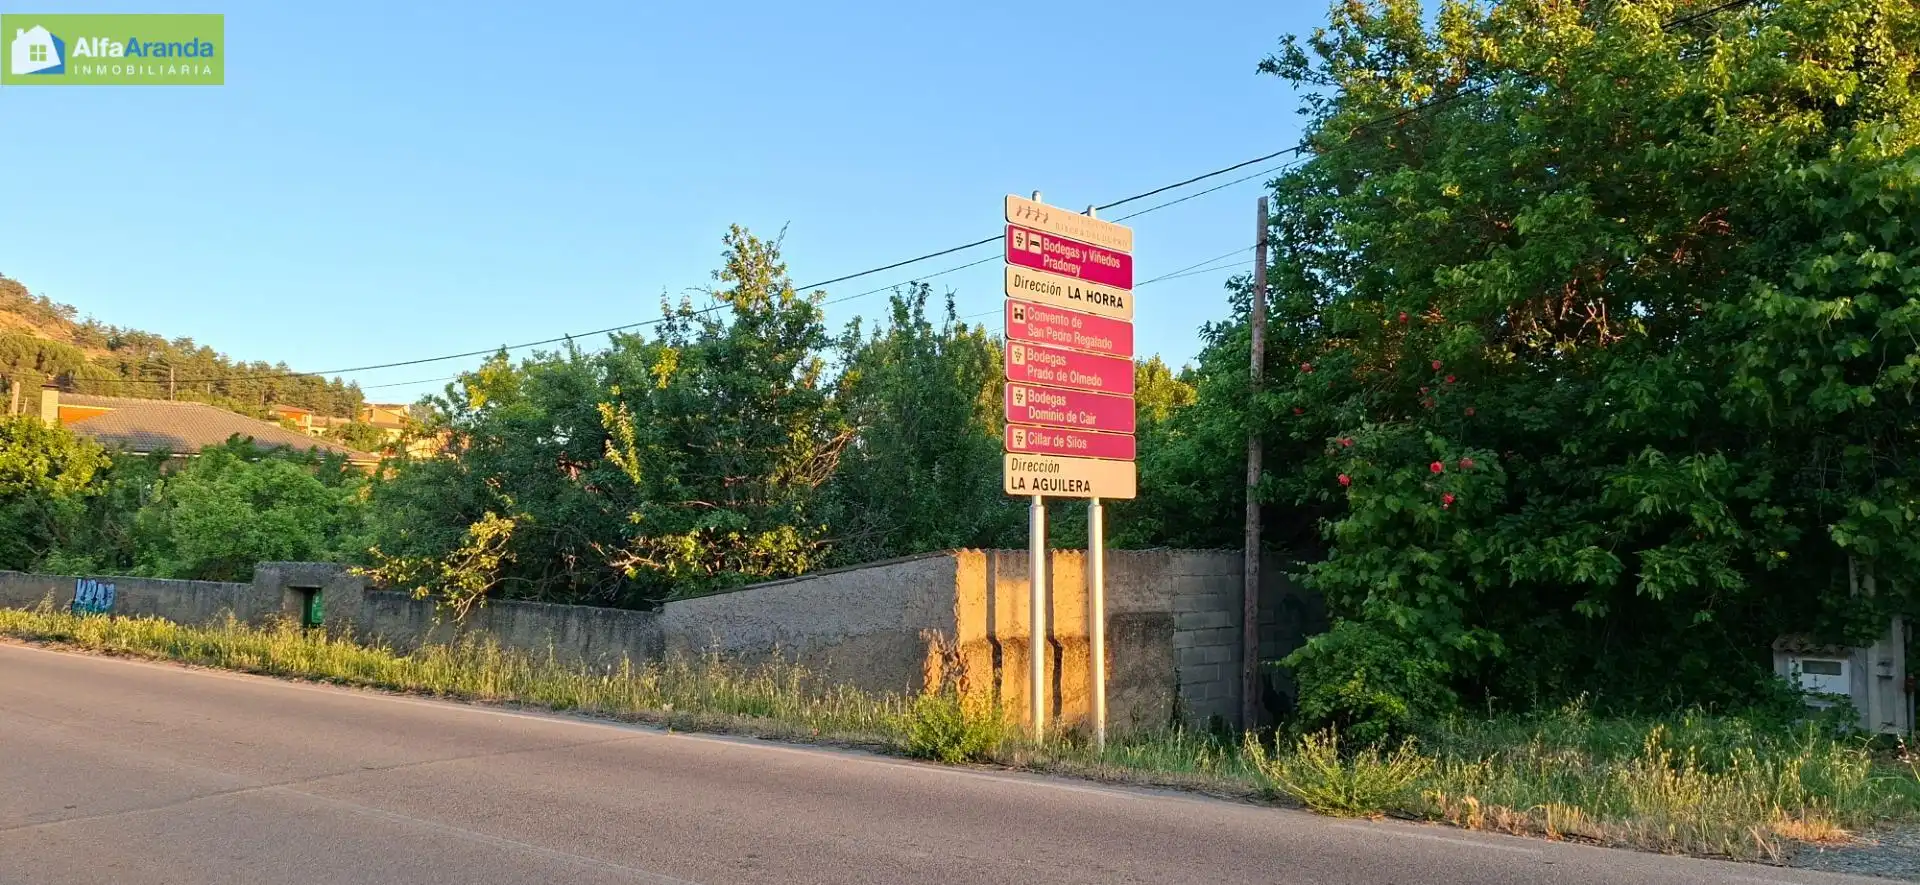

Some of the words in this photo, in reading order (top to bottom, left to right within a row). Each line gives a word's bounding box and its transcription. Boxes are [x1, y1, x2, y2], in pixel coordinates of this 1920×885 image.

[1043, 238, 1080, 258] Bodegas
[1082, 251, 1087, 263] y
[1088, 249, 1120, 268] Viñedos
[1043, 254, 1080, 276] Pradorey
[1014, 274, 1061, 296] Dirección
[1068, 286, 1081, 301] LA
[1087, 290, 1124, 309] HORRA
[1027, 307, 1069, 326] Convento
[1071, 316, 1082, 328] de
[1027, 323, 1044, 338] San
[1047, 326, 1072, 342] Pedro
[1074, 332, 1112, 349] Regalado
[1027, 348, 1066, 367] Bodegas
[1027, 364, 1053, 379] Prado
[1056, 369, 1067, 382] de
[1070, 370, 1102, 387] Olmedo
[1028, 389, 1066, 408] Bodegas
[1029, 405, 1064, 421] Dominio
[1066, 409, 1077, 423] de
[1080, 411, 1096, 425] Cair
[1028, 431, 1051, 446] Cillar
[1054, 435, 1064, 447] de
[1066, 435, 1087, 449] Silos
[1012, 458, 1060, 473] Dirección
[1012, 477, 1026, 490] LA
[1032, 478, 1091, 493] AGUILERA
